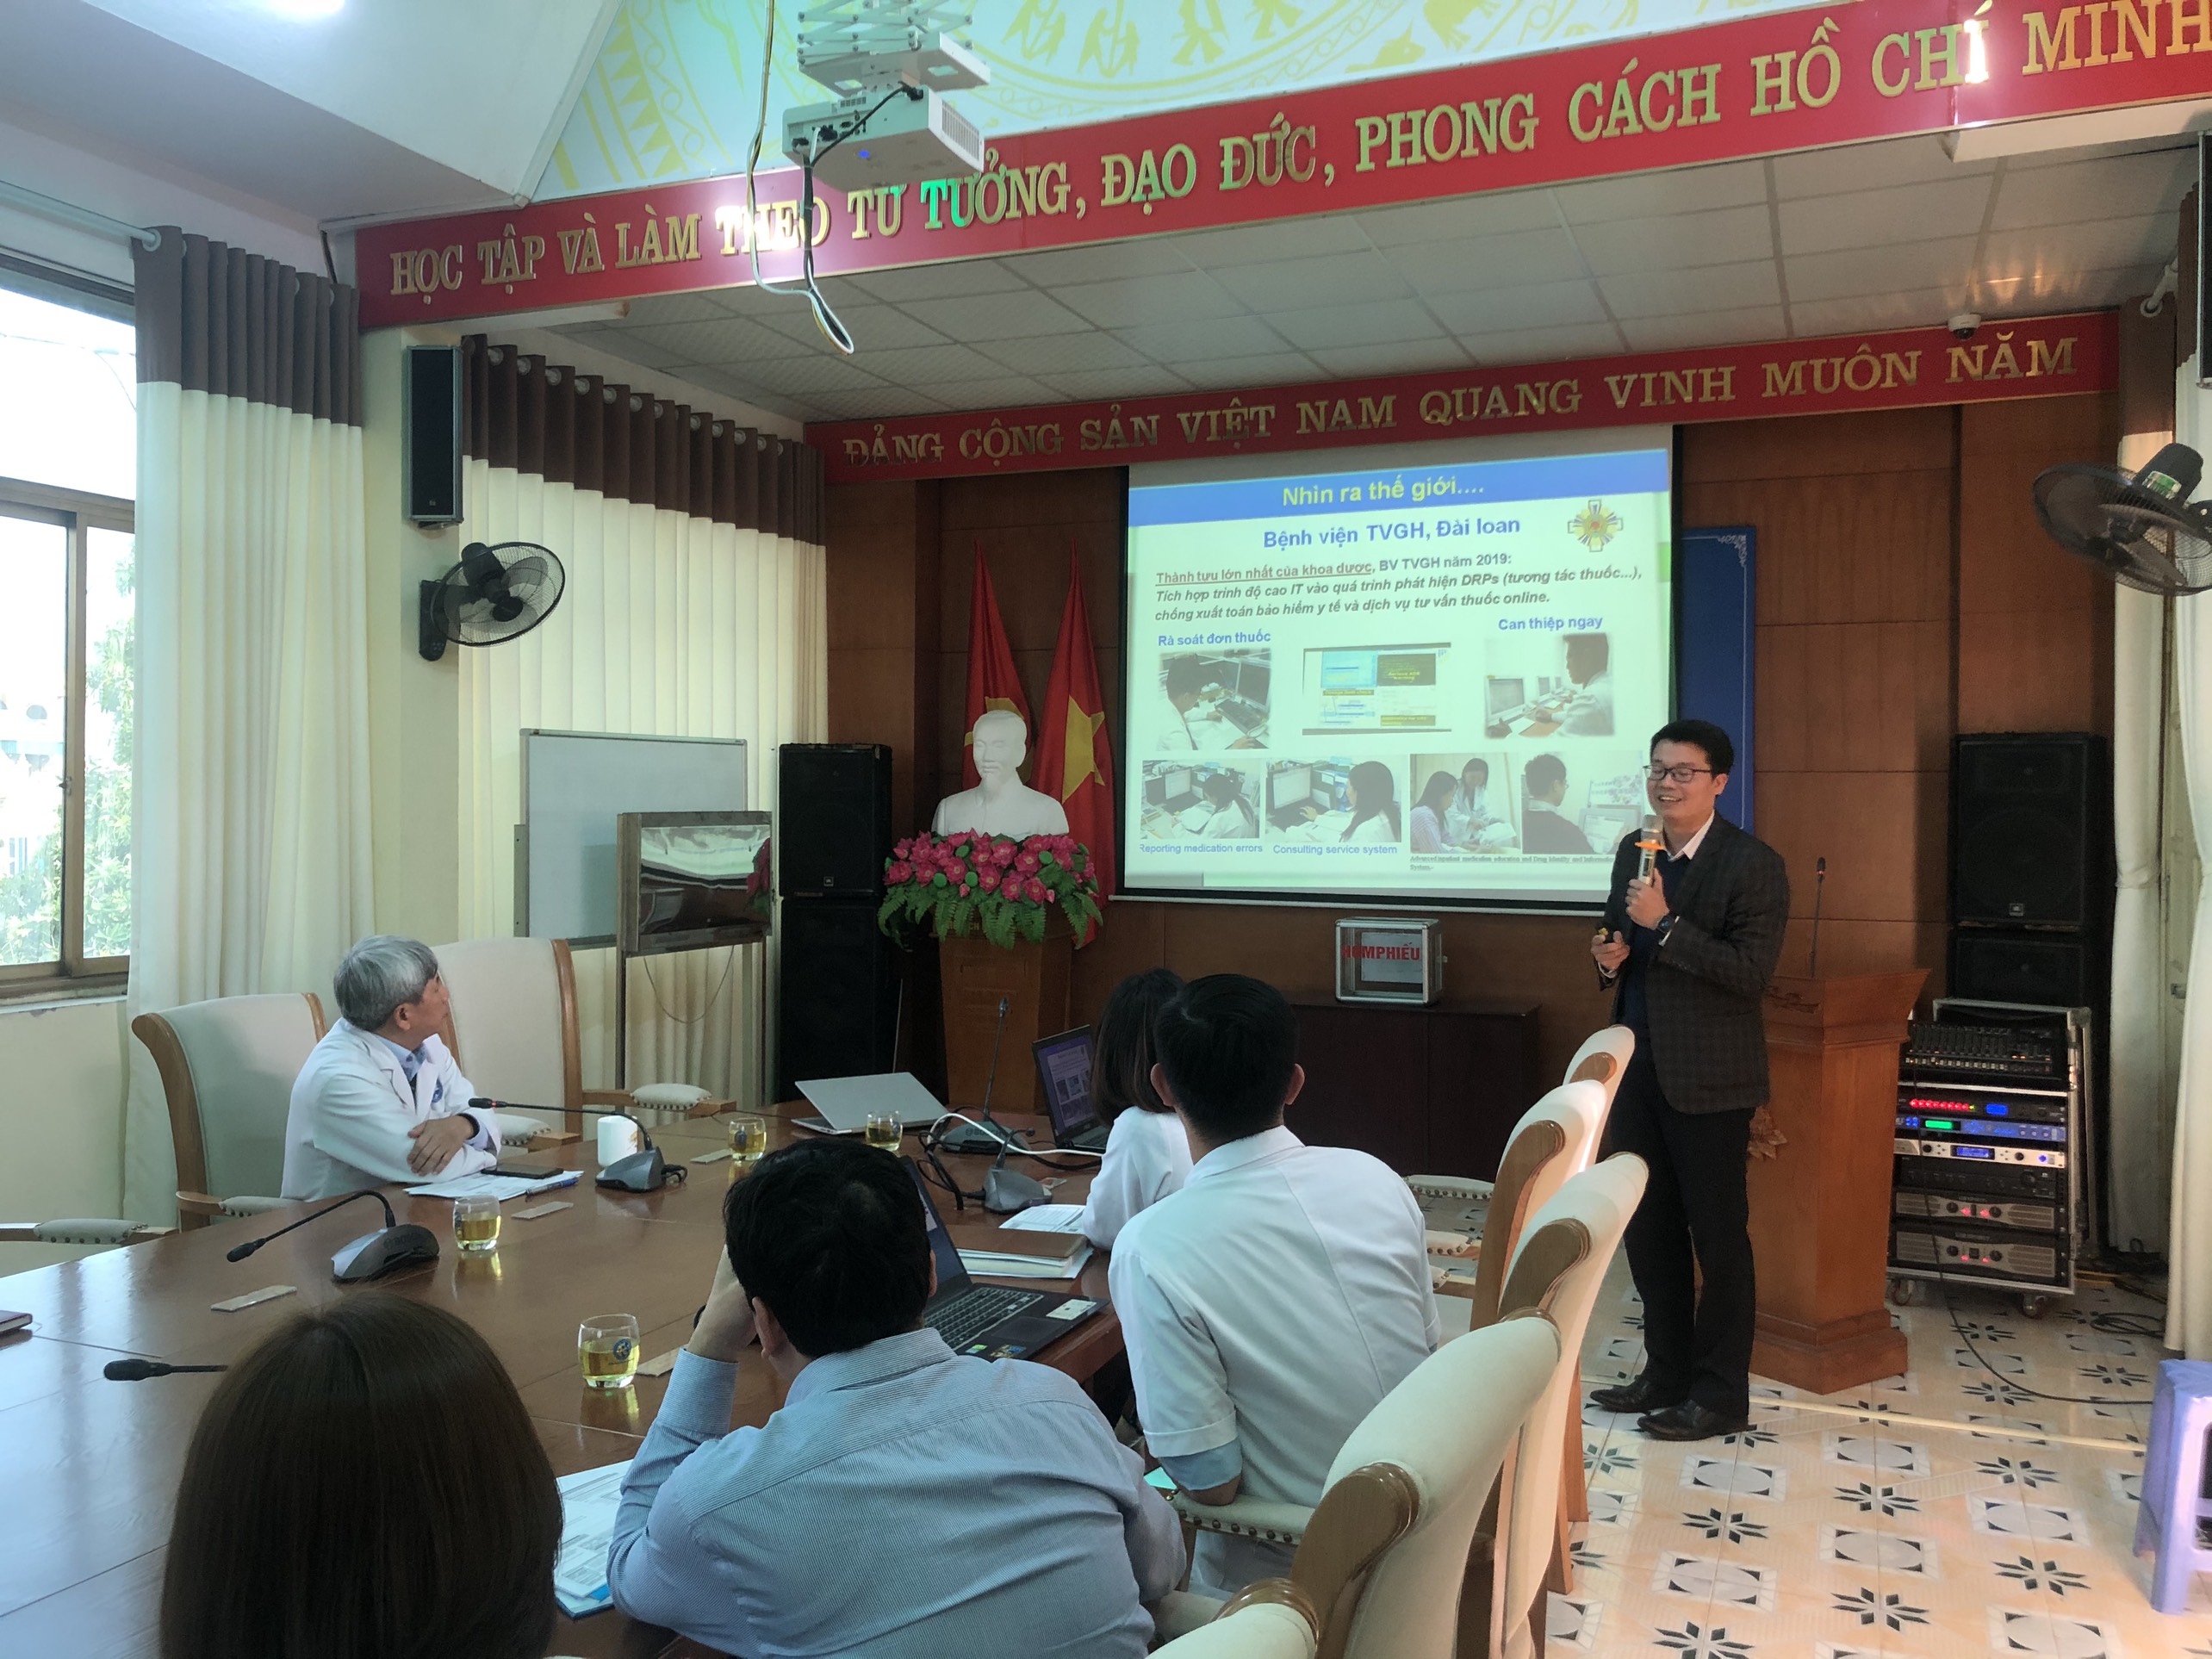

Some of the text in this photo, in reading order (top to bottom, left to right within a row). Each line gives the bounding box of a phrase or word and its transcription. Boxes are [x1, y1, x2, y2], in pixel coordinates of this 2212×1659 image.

[390, 244, 463, 305] HỌC
[477, 223, 545, 295] TẬP
[556, 212, 605, 275] VÀ
[614, 203, 702, 268] LÀM
[715, 196, 831, 255] THEO
[1100, 143, 1196, 215] ĐẠO
[1219, 111, 1335, 188] ĐỨC,
[1354, 92, 1539, 172] PHONG
[1569, 57, 1722, 143] CÁCH
[1750, 16, 1842, 116] HỒ
[1872, 3, 1992, 97] CHÍ
[2022, 0, 2212, 76] MINH
[842, 332, 2078, 467] ĐẢNG CỘNG SẢN VIỆT NAM QUANG VINH MUÔN NĂM
[1339, 489, 1362, 503] ra
[1369, 475, 1405, 500] thế
[1264, 519, 1520, 551] Bệnh viện TVGH, Đài loan
[1156, 569, 1195, 584] Thành
[1302, 562, 1333, 576] khoa
[1379, 560, 1398, 571] BV
[1401, 557, 1440, 569] TVGH
[1444, 555, 1473, 569] năm
[1476, 553, 1513, 567] 2019:
[1156, 588, 1181, 602] Tích
[1245, 583, 1262, 599] độ
[1264, 586, 1287, 597] cao
[1291, 583, 1303, 595] IT
[1306, 582, 1329, 594] vào
[1333, 581, 1358, 595] quá
[1395, 575, 1426, 593] phát
[1428, 575, 1457, 590] hiện
[1461, 573, 1499, 587] DRPs
[1555, 569, 1576, 581] tác
[1155, 606, 1194, 622] chống
[1196, 604, 1222, 619] xuất
[1226, 605, 1252, 618] toán
[1317, 603, 1326, 615] y
[1344, 600, 1358, 612] và
[1498, 616, 1603, 632] Can thiệp ngay
[1159, 628, 1271, 647] Rà soát đơn thuốc
[1184, 843, 1233, 853] medication
[1236, 844, 1263, 853] errors
[1273, 844, 1398, 855] Consulting service system
